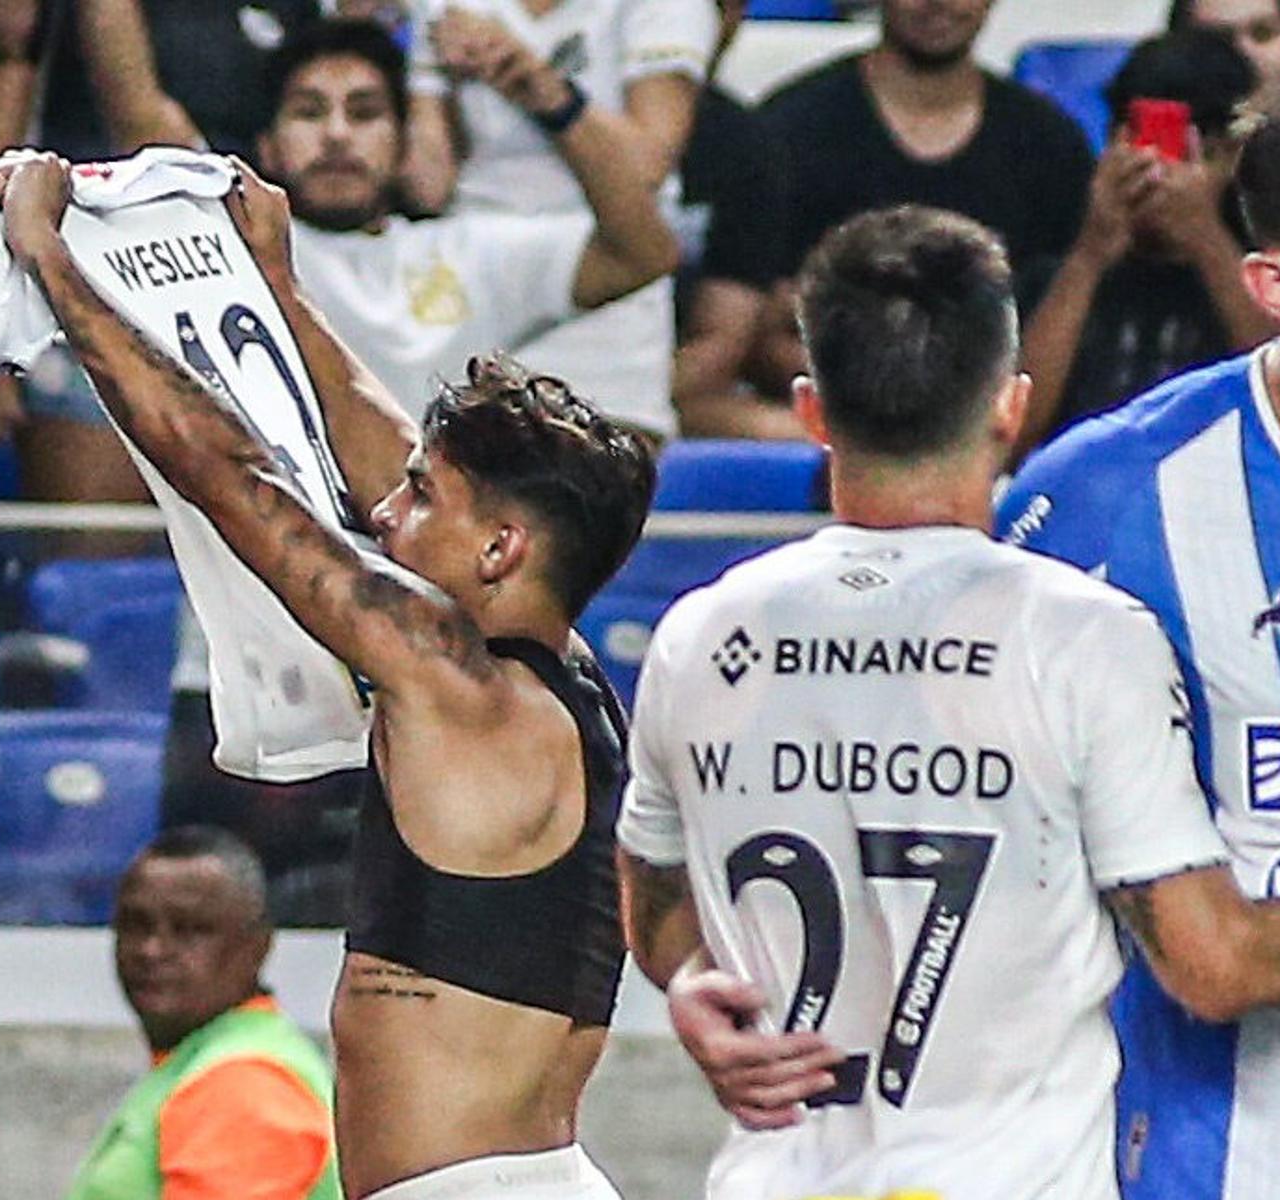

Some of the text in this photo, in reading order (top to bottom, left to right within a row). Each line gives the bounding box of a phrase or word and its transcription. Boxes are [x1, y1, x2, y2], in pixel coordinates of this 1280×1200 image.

[104, 232, 233, 291] WESLLEY
[774, 638, 999, 677] BINANCE
[688, 741, 1015, 800] W. DUBGOD
[725, 826, 999, 1109] 27
